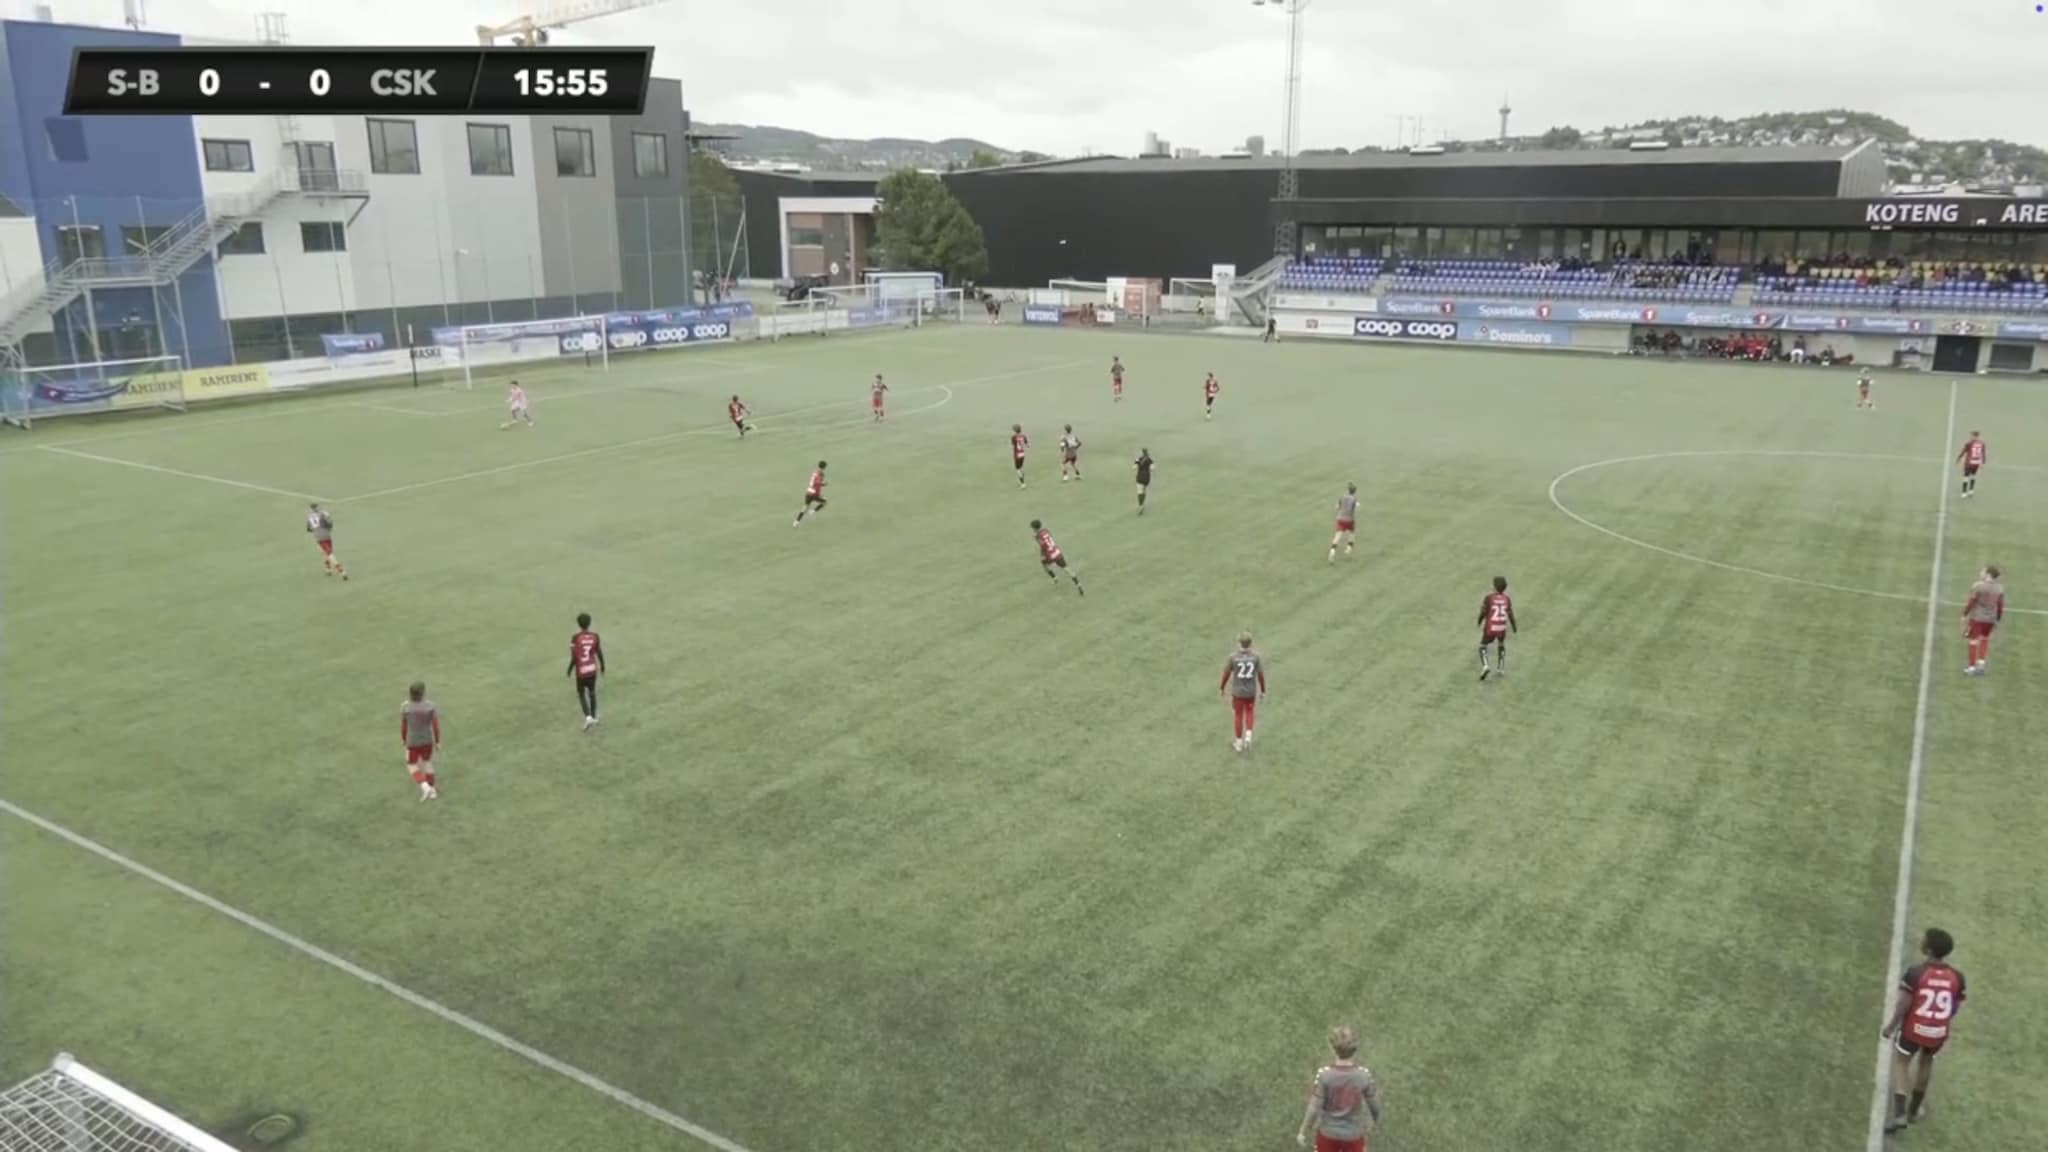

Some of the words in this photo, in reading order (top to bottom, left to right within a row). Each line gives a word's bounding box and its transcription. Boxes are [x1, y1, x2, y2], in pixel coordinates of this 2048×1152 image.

[1865, 203, 1960, 223] KOTENG
[653, 326, 689, 342] coop
[694, 323, 727, 339] coop
[1356, 320, 1403, 336] coop
[1407, 322, 1455, 339] coop
[1489, 328, 1552, 343] Domino's
[199, 371, 258, 387] RAMIRENT
[1236, 661, 1255, 679] 22
[1914, 988, 1953, 1020] 29
